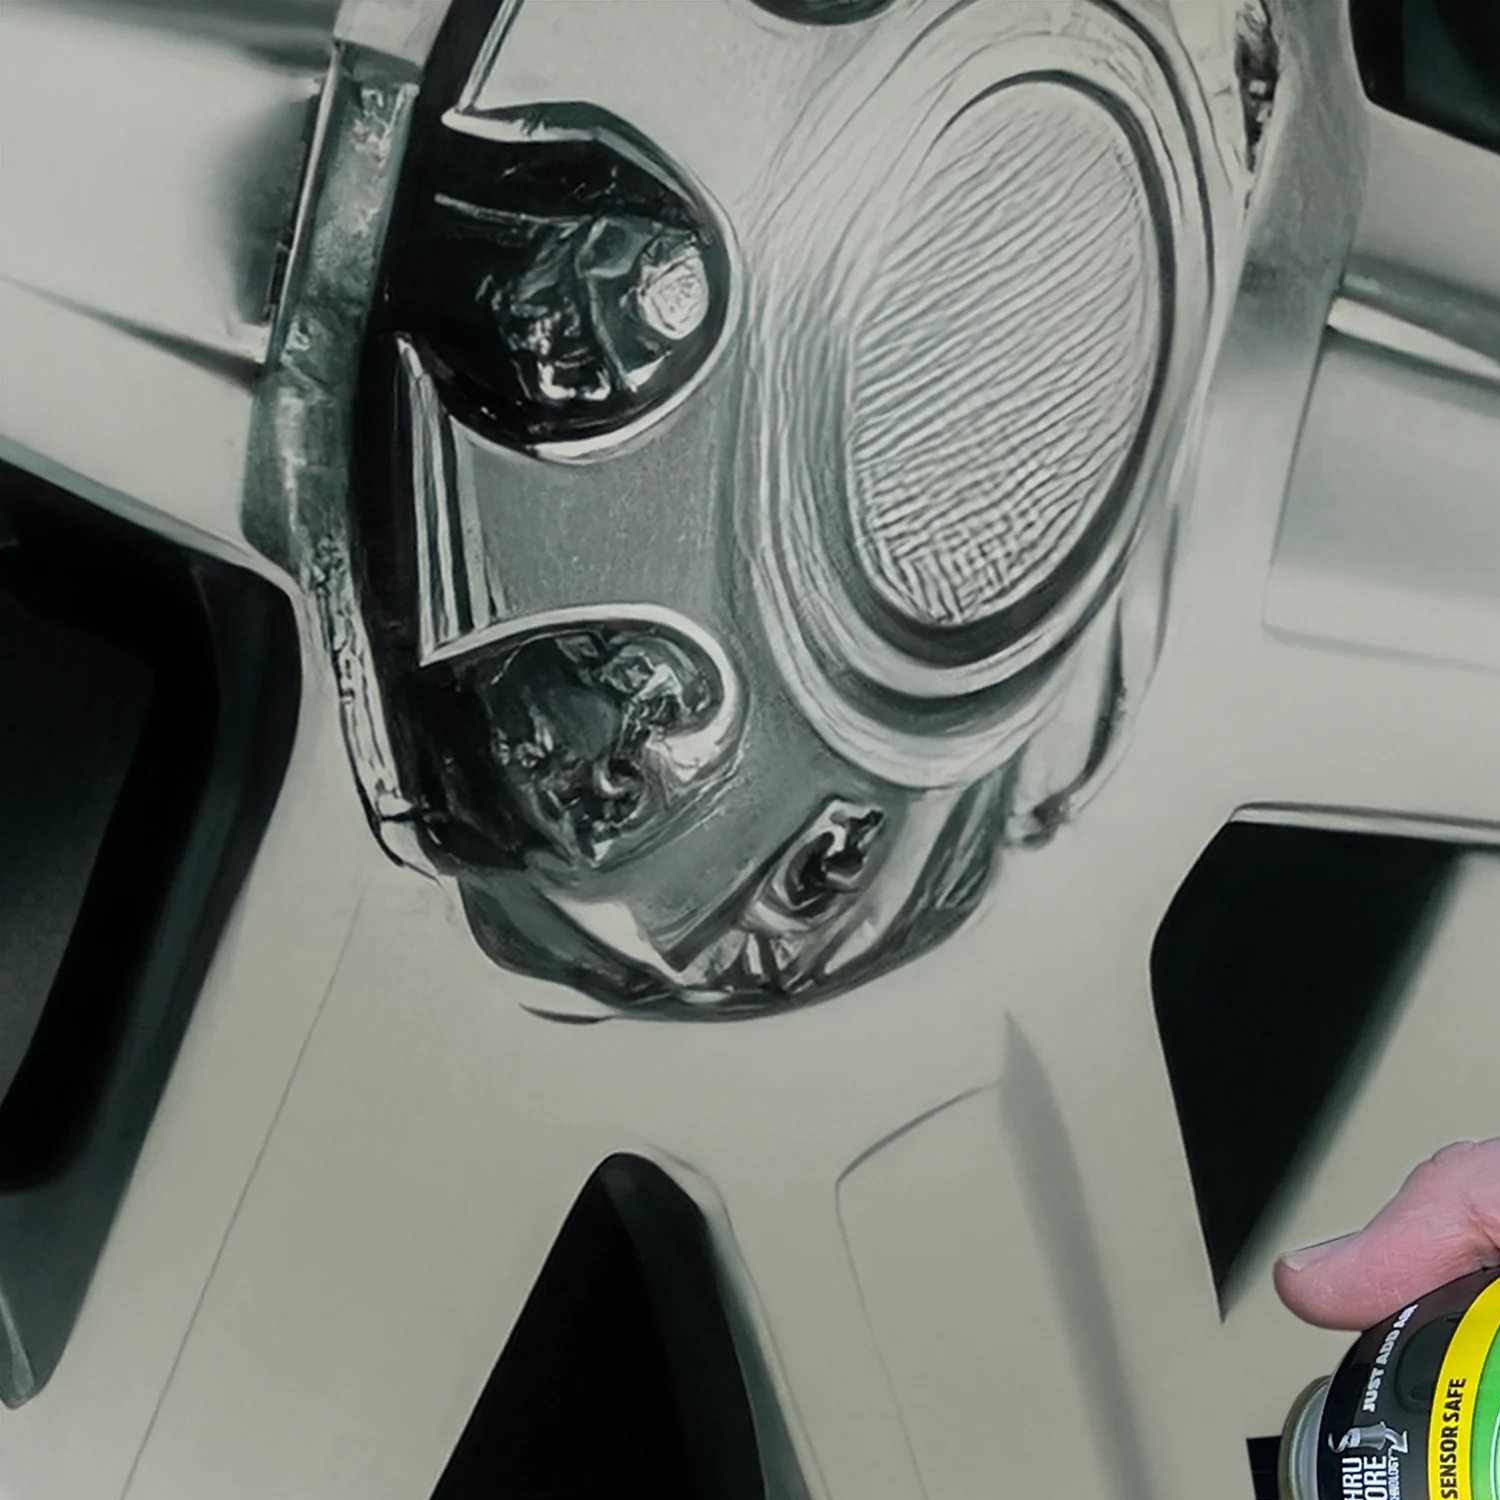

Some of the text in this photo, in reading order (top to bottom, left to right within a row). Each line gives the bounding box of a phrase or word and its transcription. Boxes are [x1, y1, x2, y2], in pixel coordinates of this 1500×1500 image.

[1362, 1367, 1385, 1413] JUST
[1375, 1329, 1401, 1365] ADD
[1438, 1377, 1466, 1421] SAFE
[1438, 1421, 1457, 1499] SENSOR
